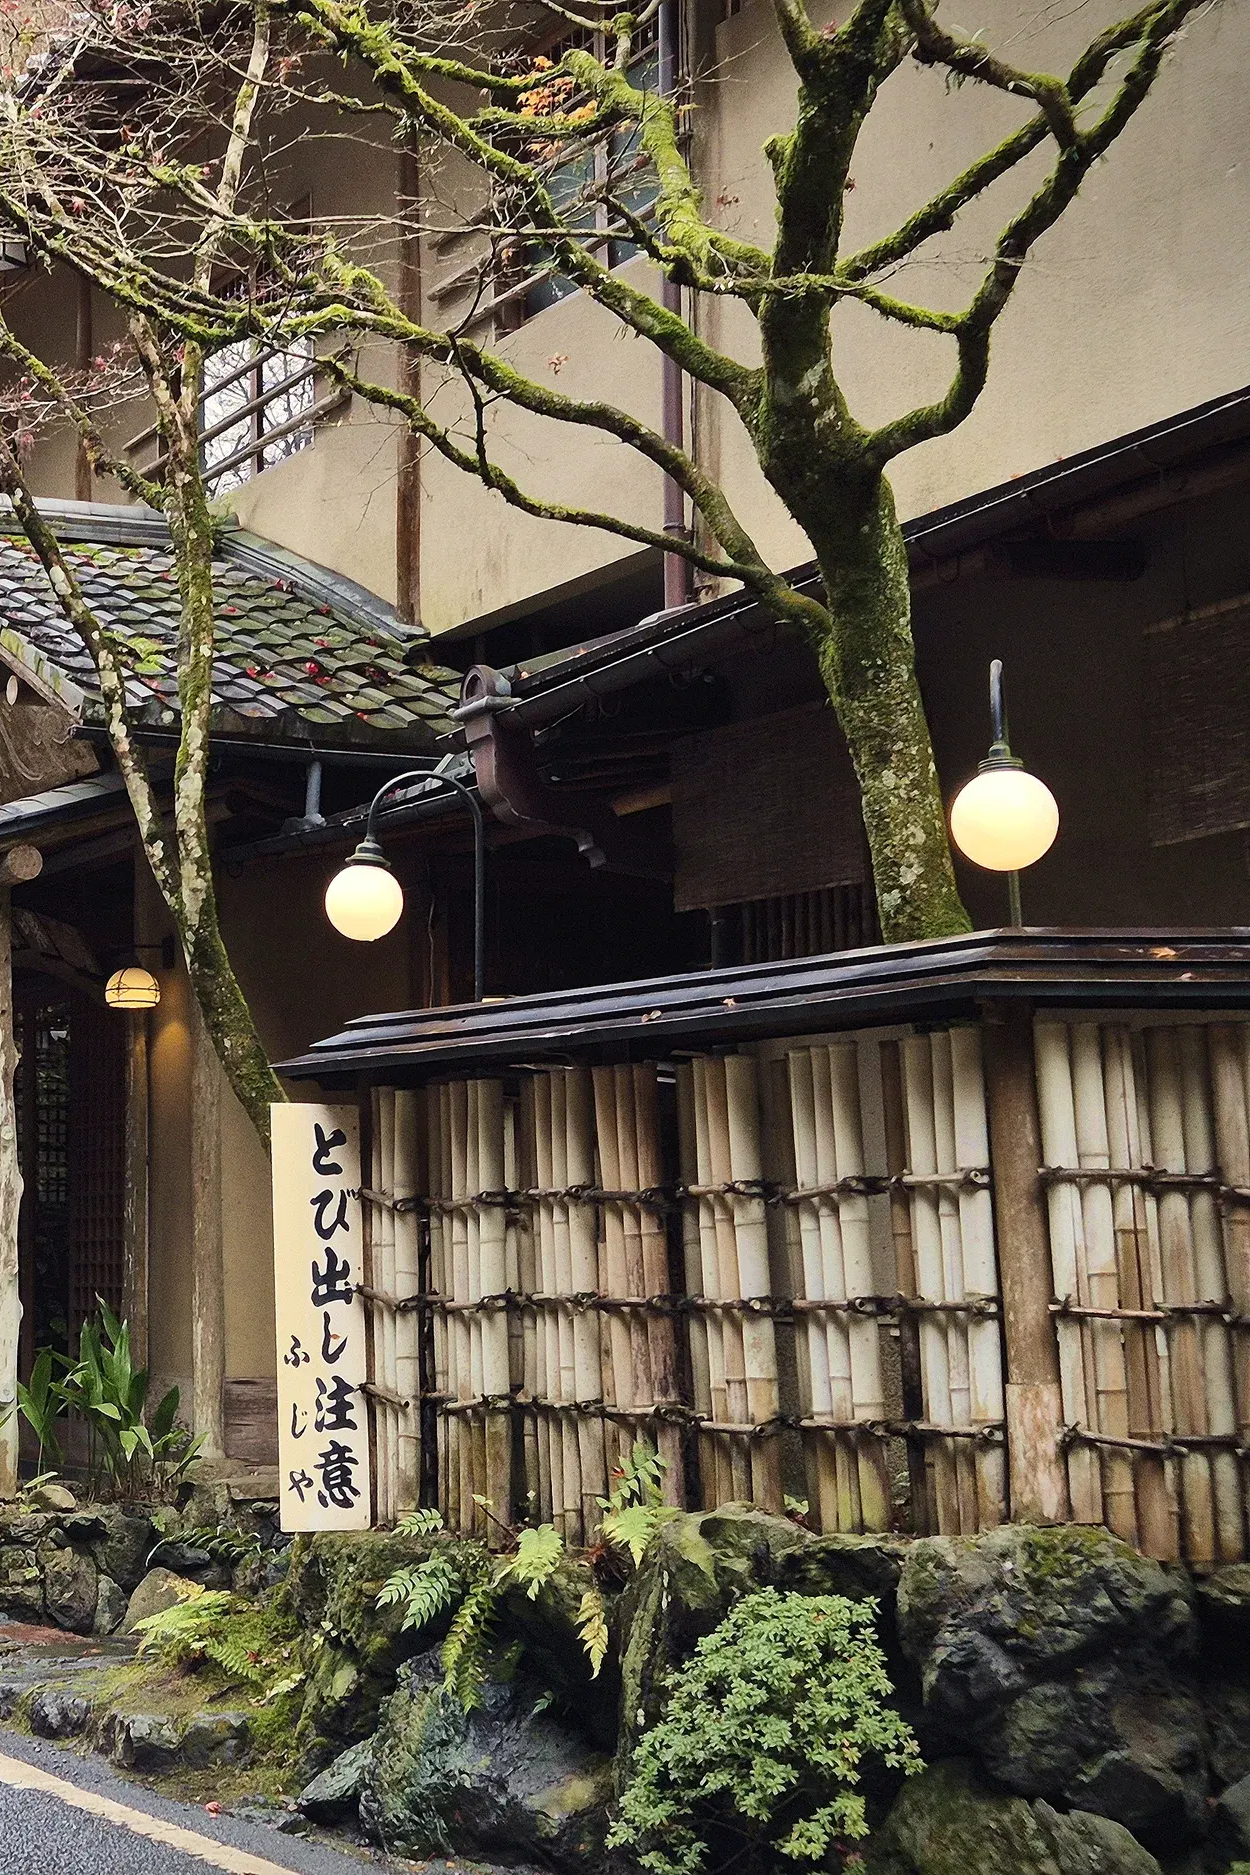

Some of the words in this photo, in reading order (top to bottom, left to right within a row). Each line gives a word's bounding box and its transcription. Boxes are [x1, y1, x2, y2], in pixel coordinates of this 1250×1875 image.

[283, 1335, 314, 1502] ふじや
[310, 1122, 361, 1509] とび出し注意
